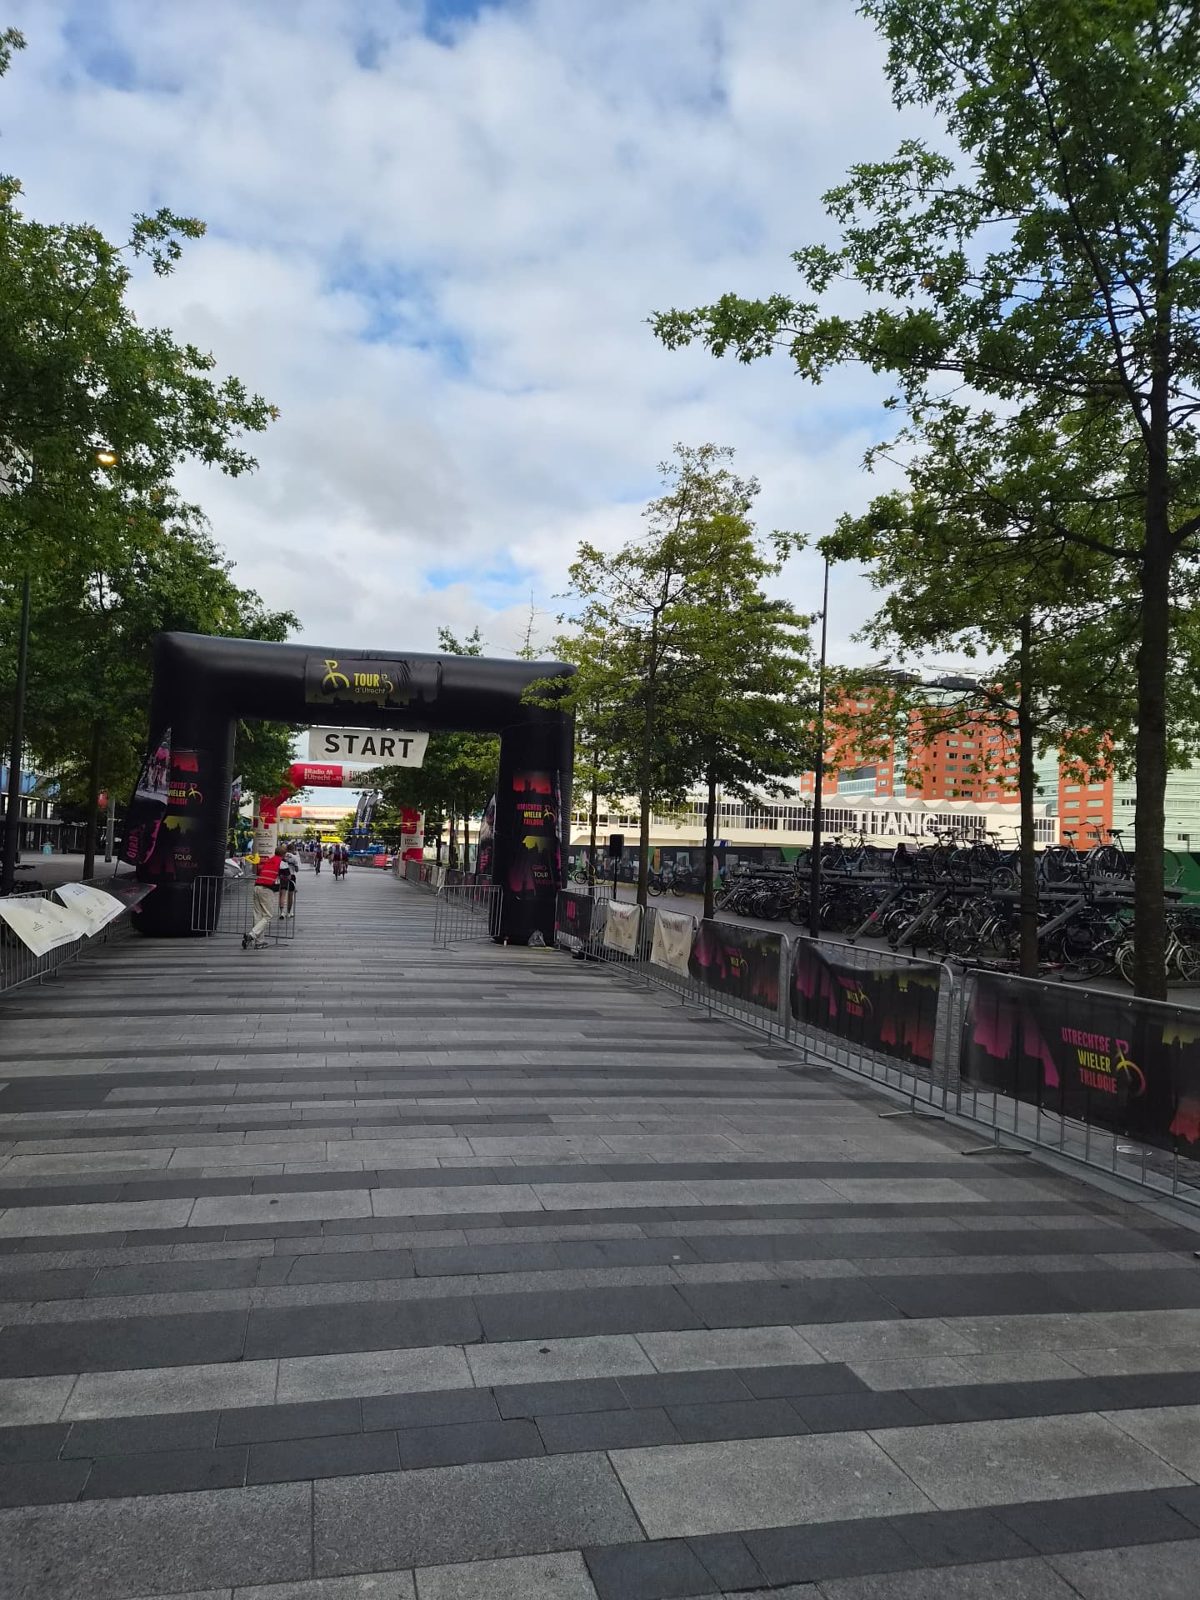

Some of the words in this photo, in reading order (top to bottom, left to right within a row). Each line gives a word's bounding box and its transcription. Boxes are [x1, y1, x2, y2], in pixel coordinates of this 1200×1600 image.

[353, 672, 380, 688] TOUR
[324, 733, 415, 759] START
[307, 773, 331, 781] Utrecht
[852, 810, 938, 838] TITANIC
[1061, 1026, 1111, 1053] UTRECHTSE
[1077, 1049, 1112, 1073] WIELER
[1079, 1068, 1117, 1094] TRILOGIE
